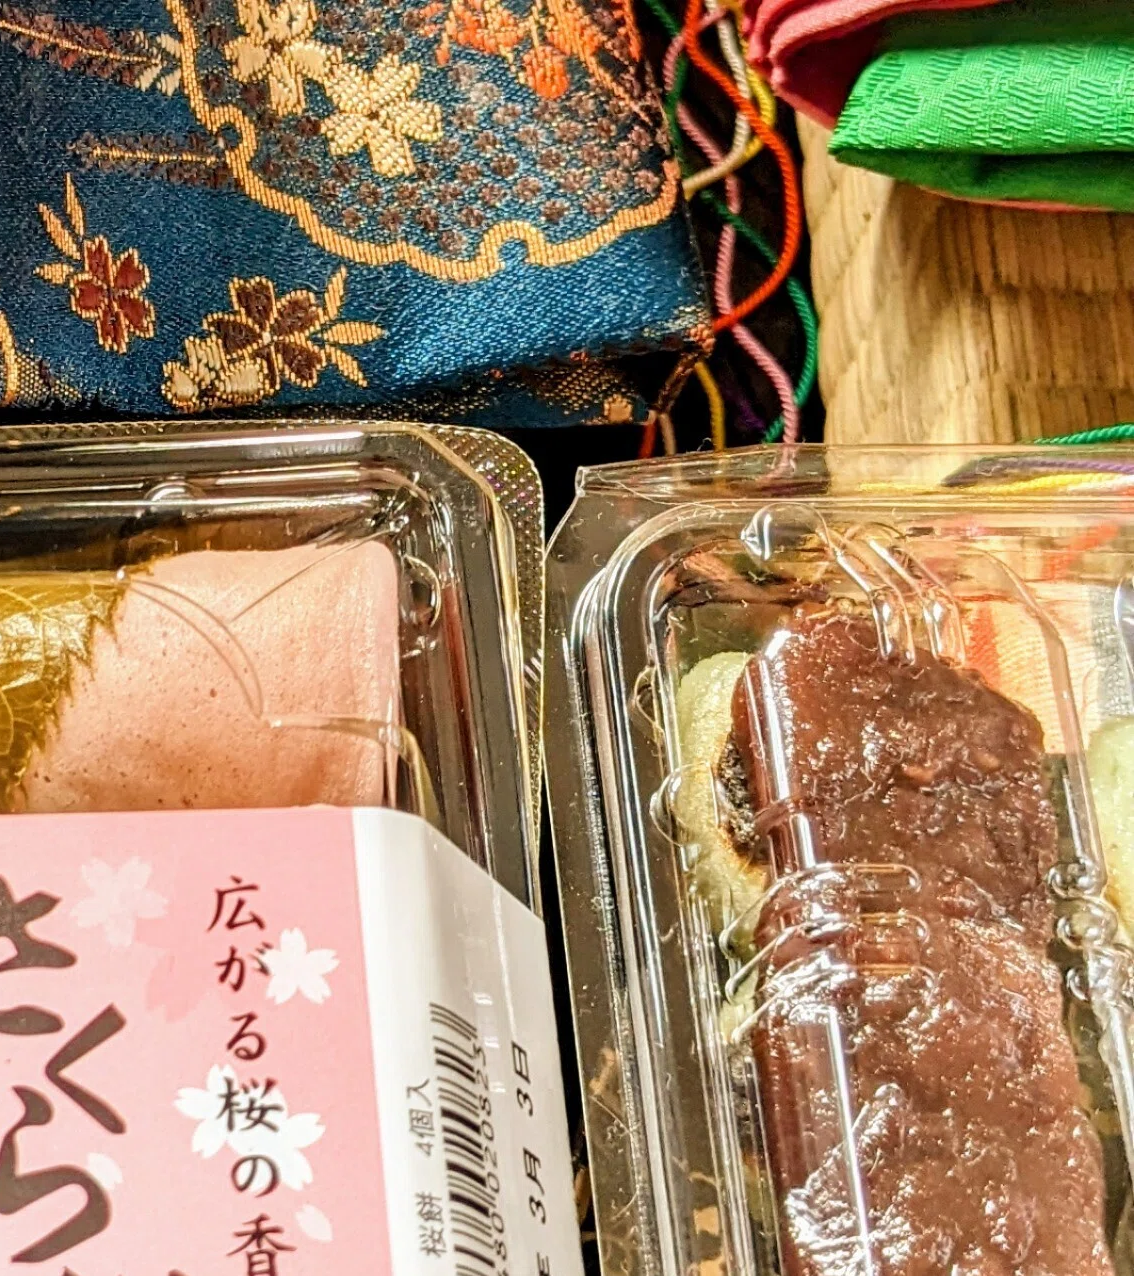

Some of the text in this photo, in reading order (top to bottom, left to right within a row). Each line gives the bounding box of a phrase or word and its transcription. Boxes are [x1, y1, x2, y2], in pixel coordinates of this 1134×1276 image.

[511, 1040, 534, 1117] 3日
[406, 1078, 445, 1258] 桜餅 4個入
[522, 1147, 547, 1225] 3月
